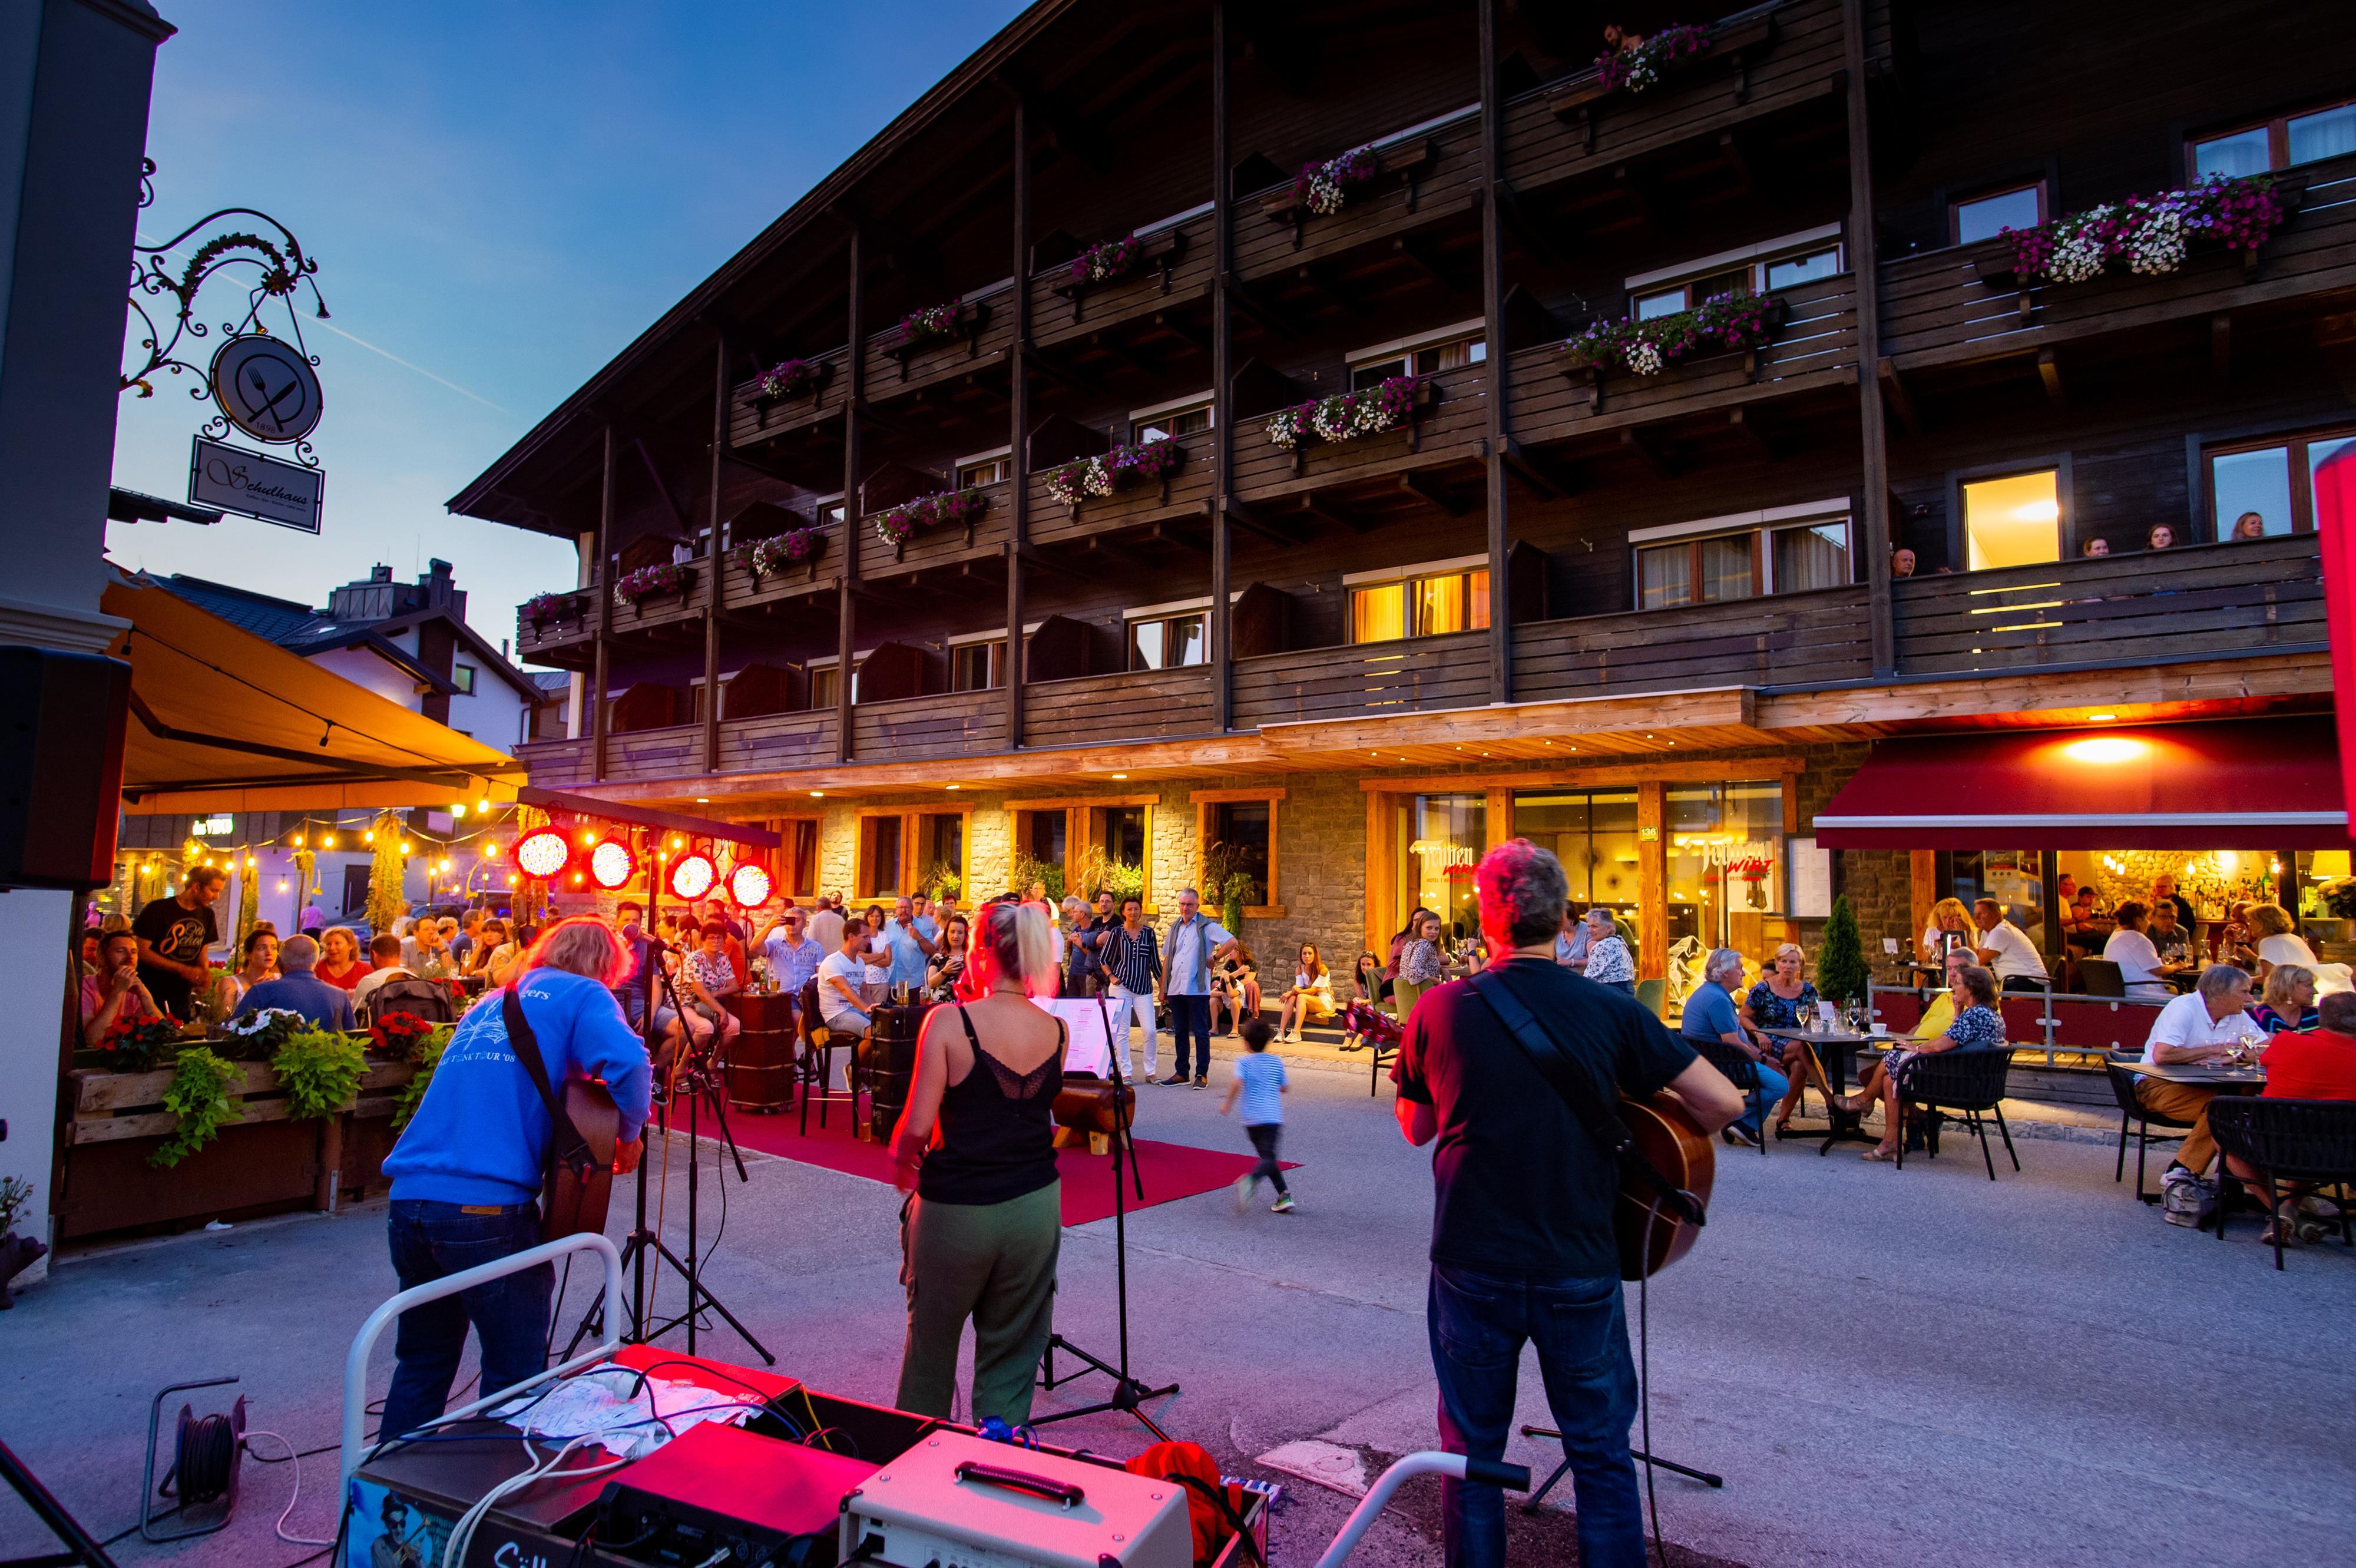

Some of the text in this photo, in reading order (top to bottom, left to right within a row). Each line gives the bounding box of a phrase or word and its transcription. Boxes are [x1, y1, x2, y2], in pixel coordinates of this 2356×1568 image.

[256, 422, 276, 434] 1898
[207, 458, 309, 505] Schulhaus
[1641, 828, 1656, 836] 136
